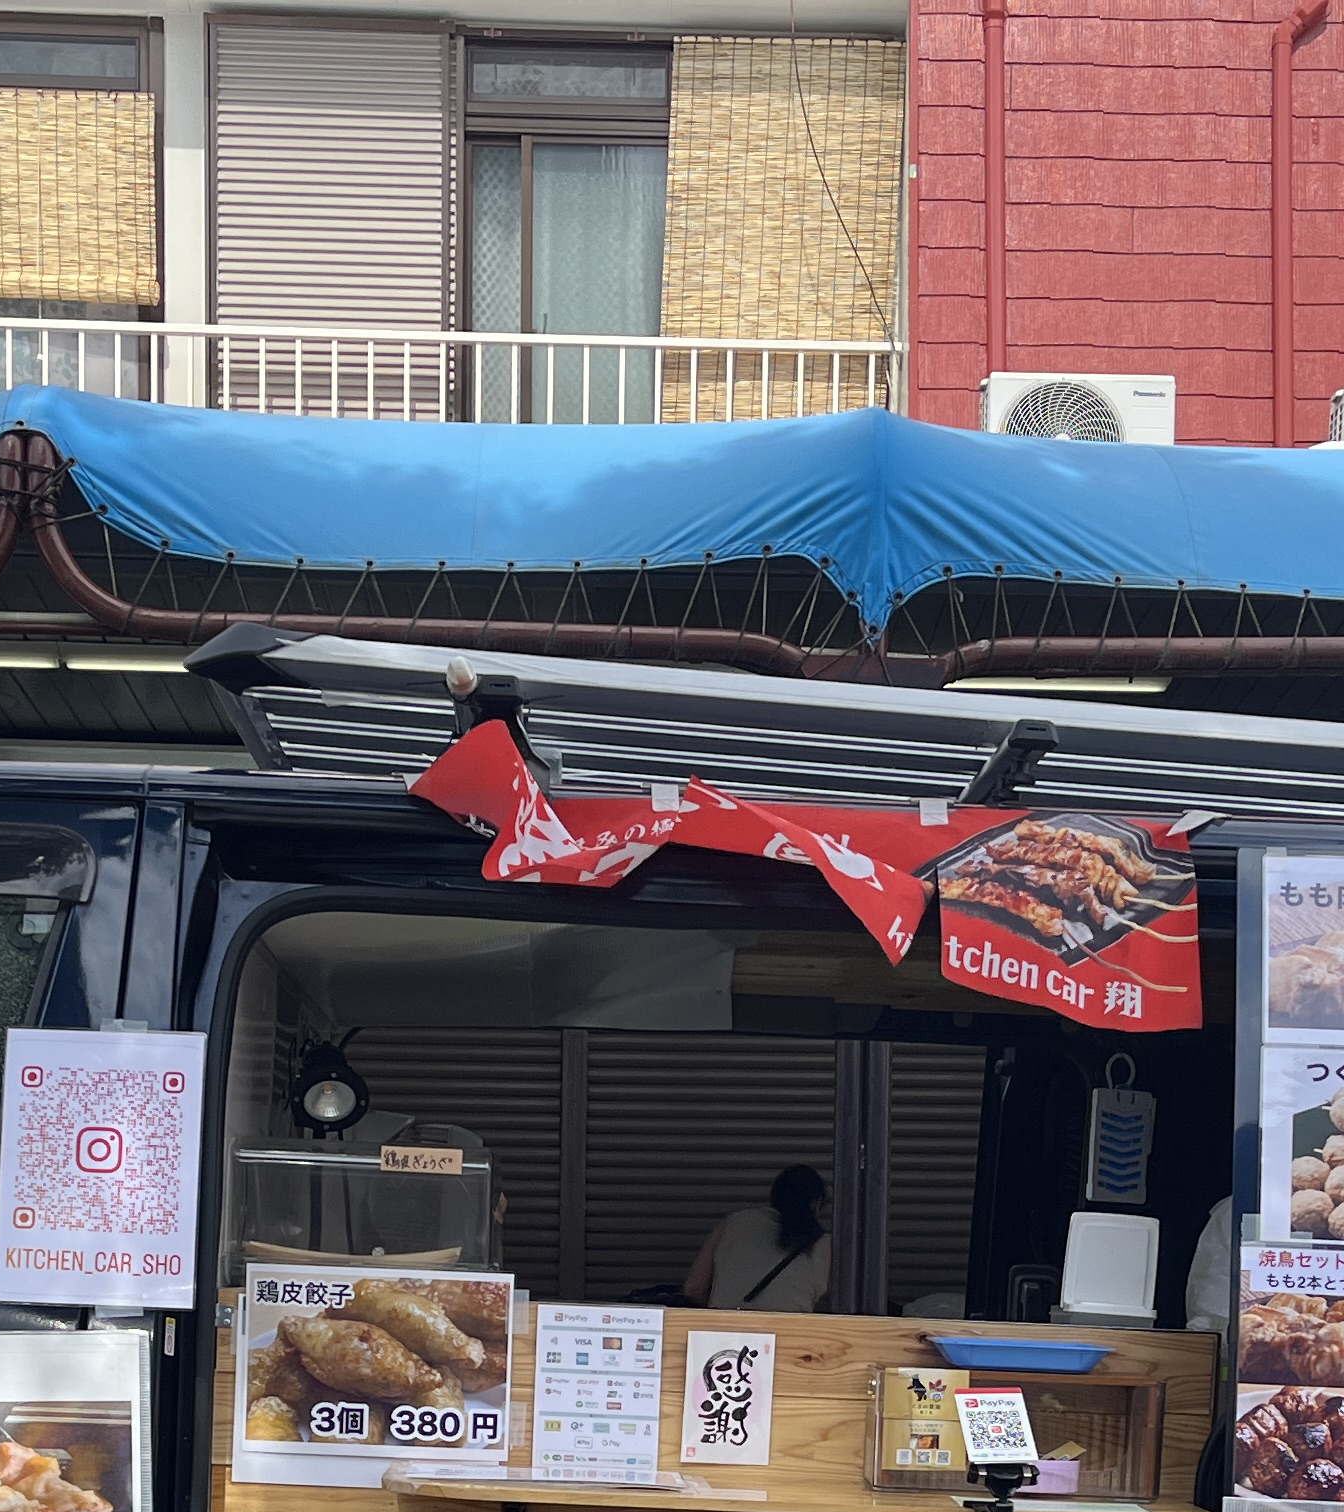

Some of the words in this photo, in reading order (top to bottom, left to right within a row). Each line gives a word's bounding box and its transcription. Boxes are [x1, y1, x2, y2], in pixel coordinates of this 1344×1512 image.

[1047, 968, 1096, 1010] car
[1104, 981, 1144, 1020] 翔
[6, 1248, 181, 1276] KITCHEN_CAR_SHO
[256, 1280, 354, 1307] 鶏皮餃子
[574, 1338, 593, 1346] VISA
[979, 1399, 1017, 1408] PayPay
[311, 1404, 367, 1436] 3個
